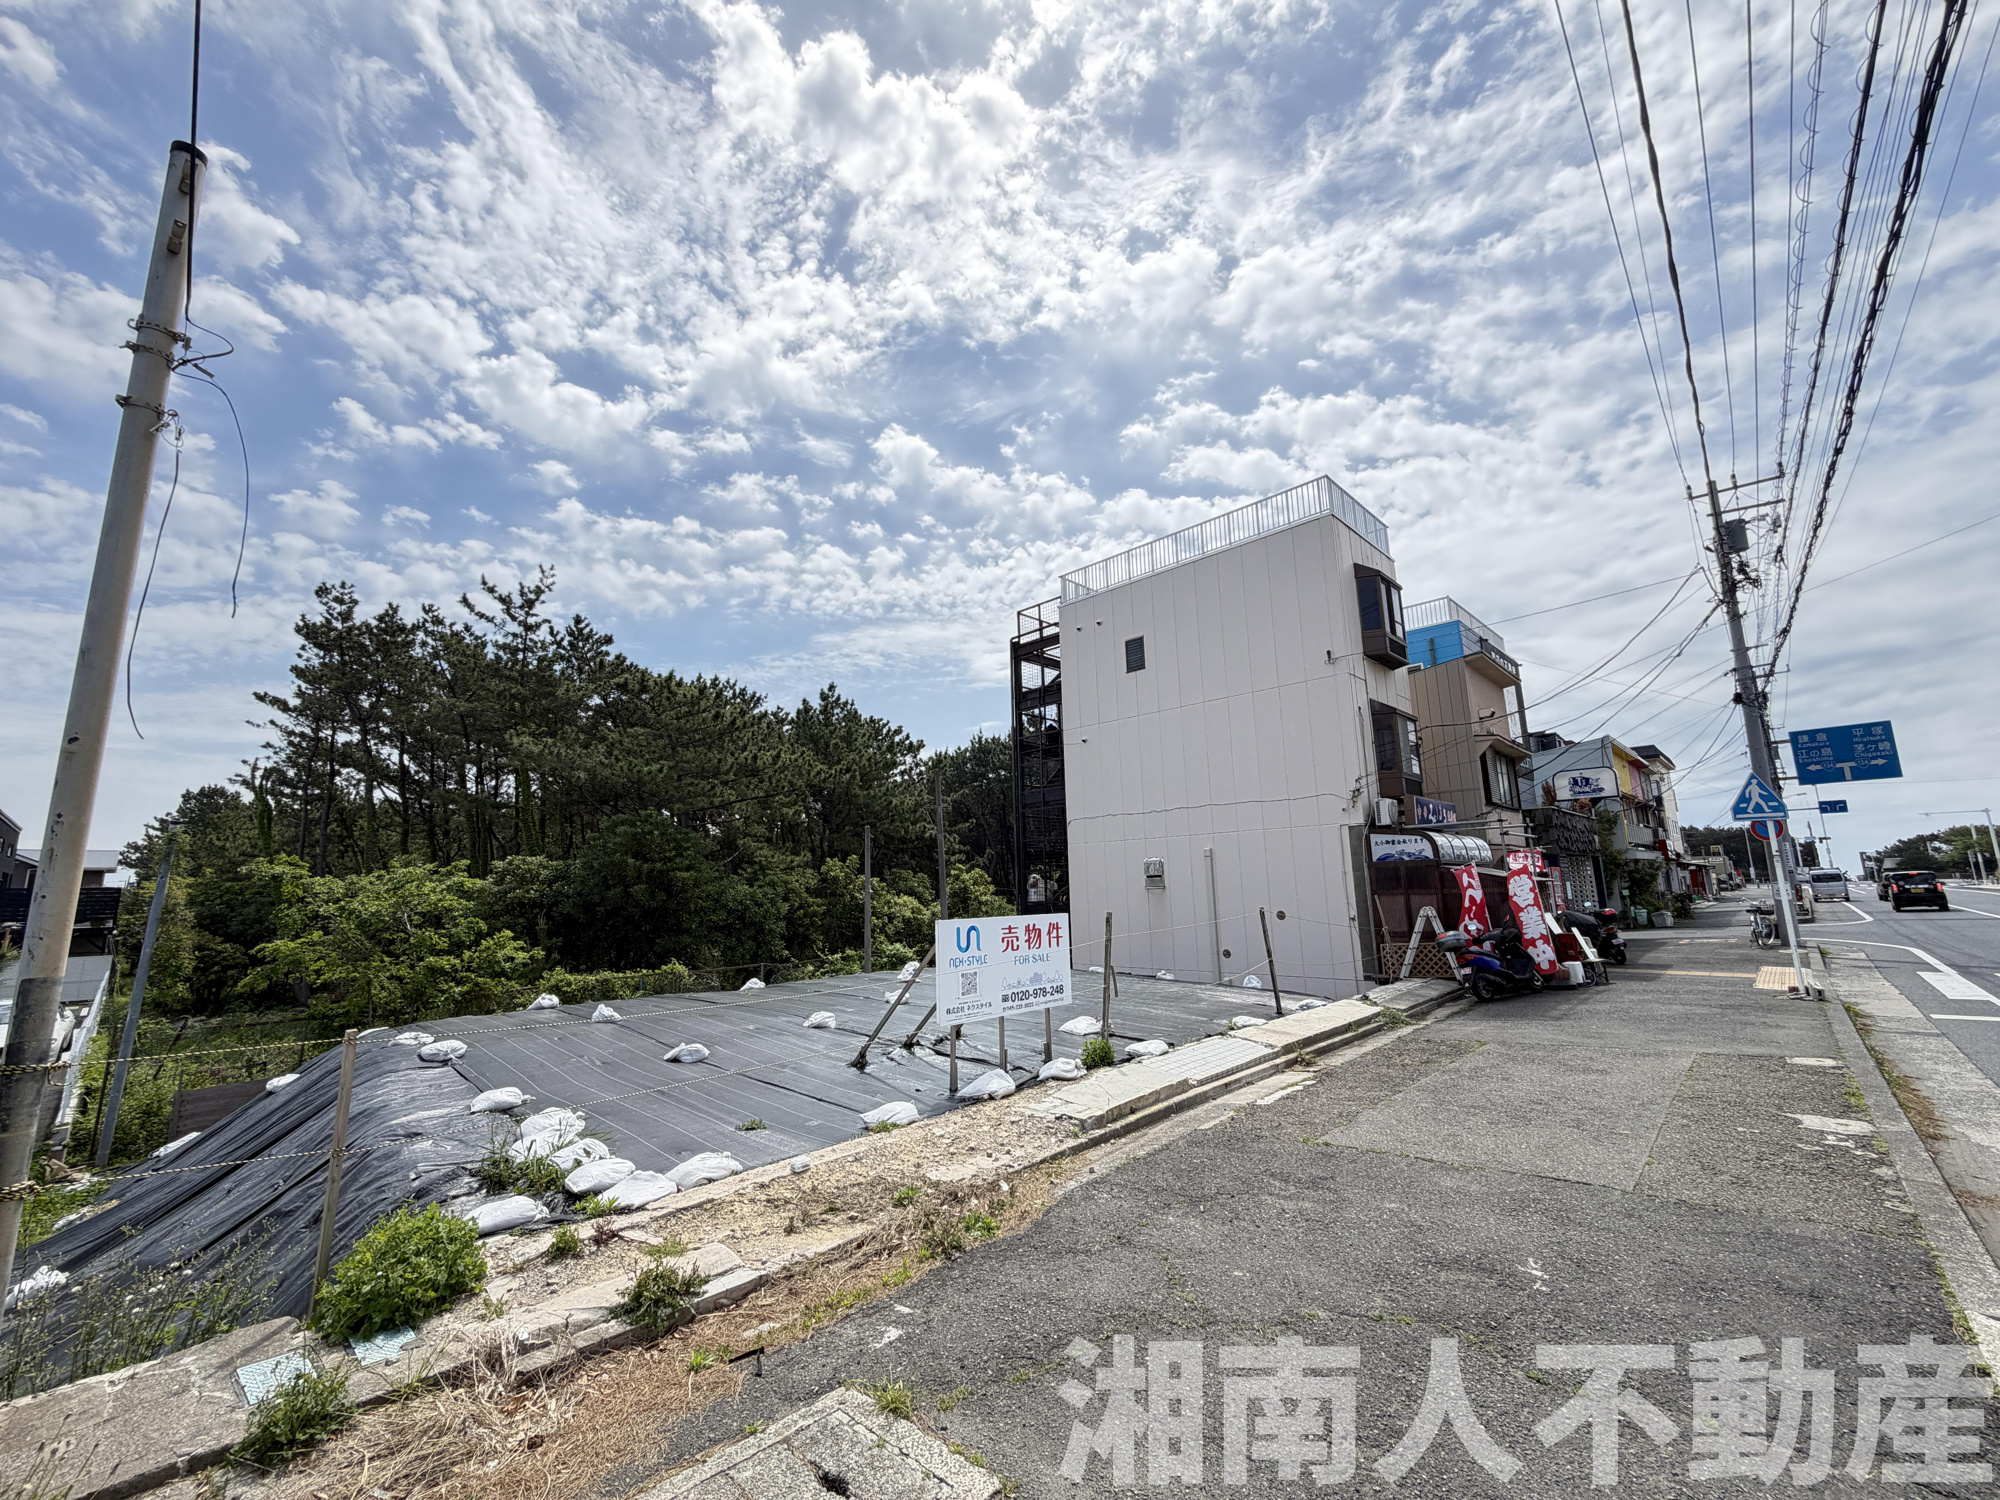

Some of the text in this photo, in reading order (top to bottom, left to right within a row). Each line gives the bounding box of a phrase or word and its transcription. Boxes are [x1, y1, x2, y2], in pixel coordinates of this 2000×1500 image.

[1798, 733, 1828, 744] 鎌倉
[1852, 727, 1885, 738] 平塚
[1798, 748, 1833, 759] 江の島
[1854, 750, 1893, 759] Chigasaki
[1508, 874, 1556, 970] 営業中
[1001, 921, 1064, 954] 売物件
[1014, 953, 1051, 966] FOR SALE
[1010, 984, 1065, 1003] 0120-978-248
[945, 1005, 965, 1016] 株式会社
[966, 1001, 993, 1012] ネクスタイル
